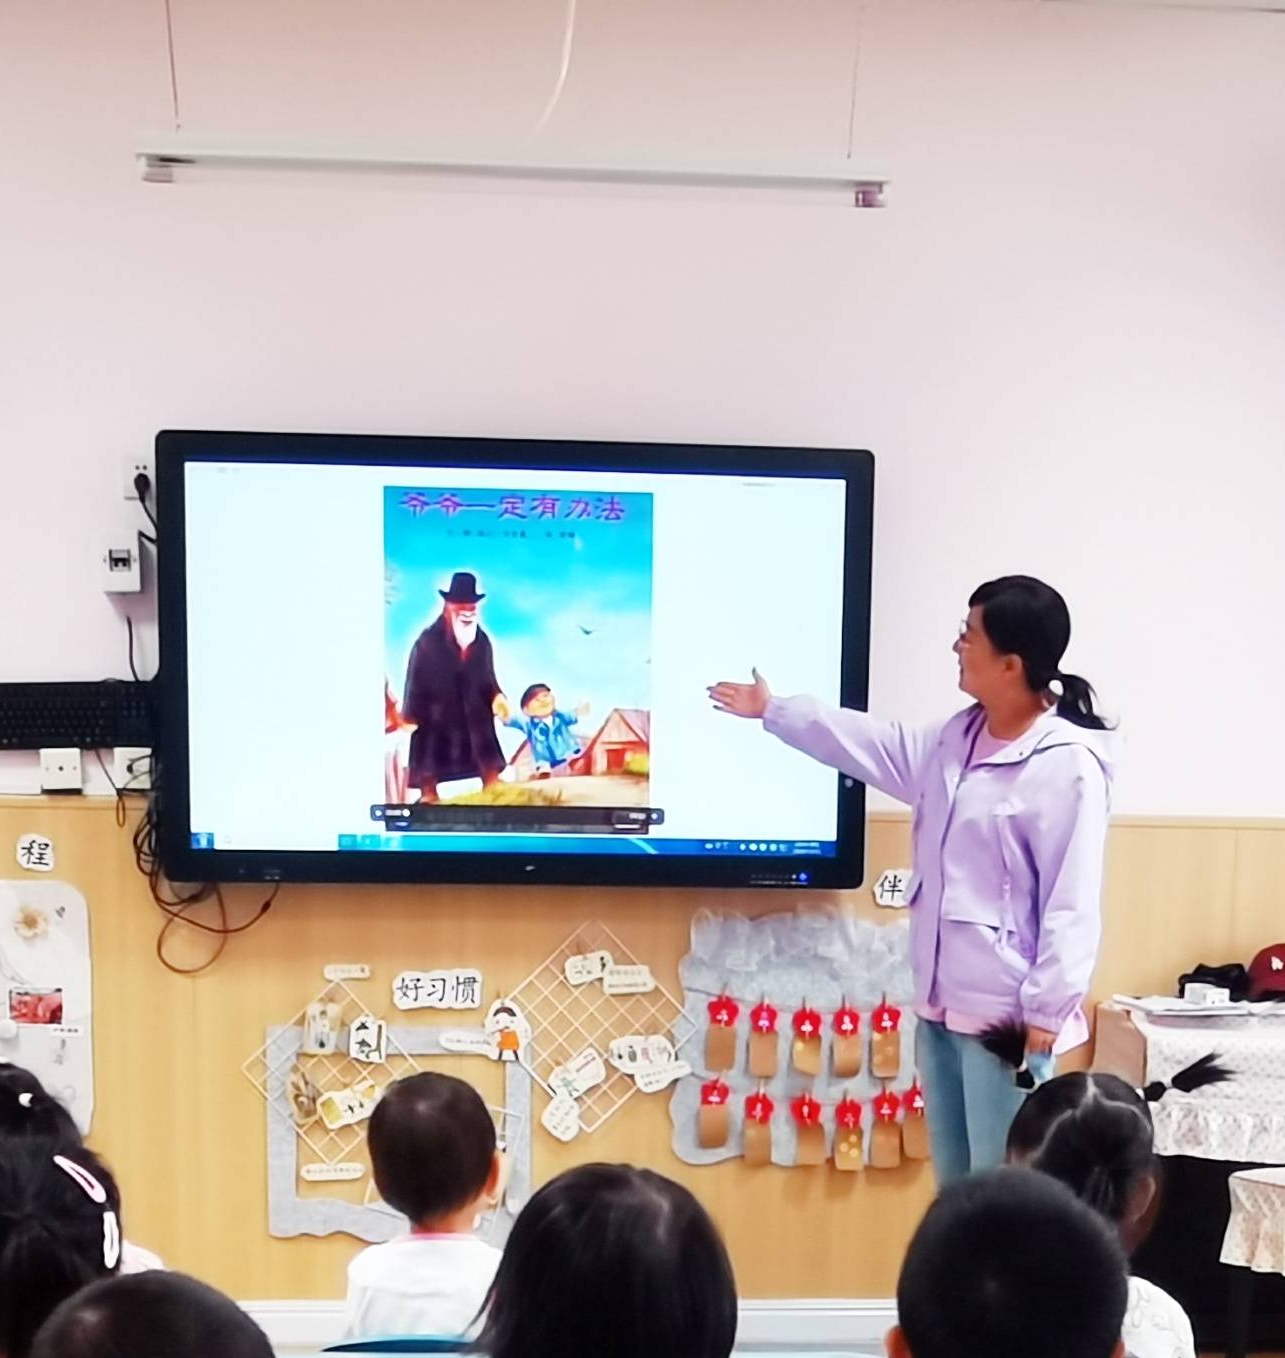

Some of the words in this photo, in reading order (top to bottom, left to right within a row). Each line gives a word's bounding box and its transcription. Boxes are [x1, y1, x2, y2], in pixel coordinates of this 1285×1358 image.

[399, 491, 625, 521] 爷爷一定有办法
[879, 875, 904, 901] 伴
[396, 975, 479, 1004] 好习惯
